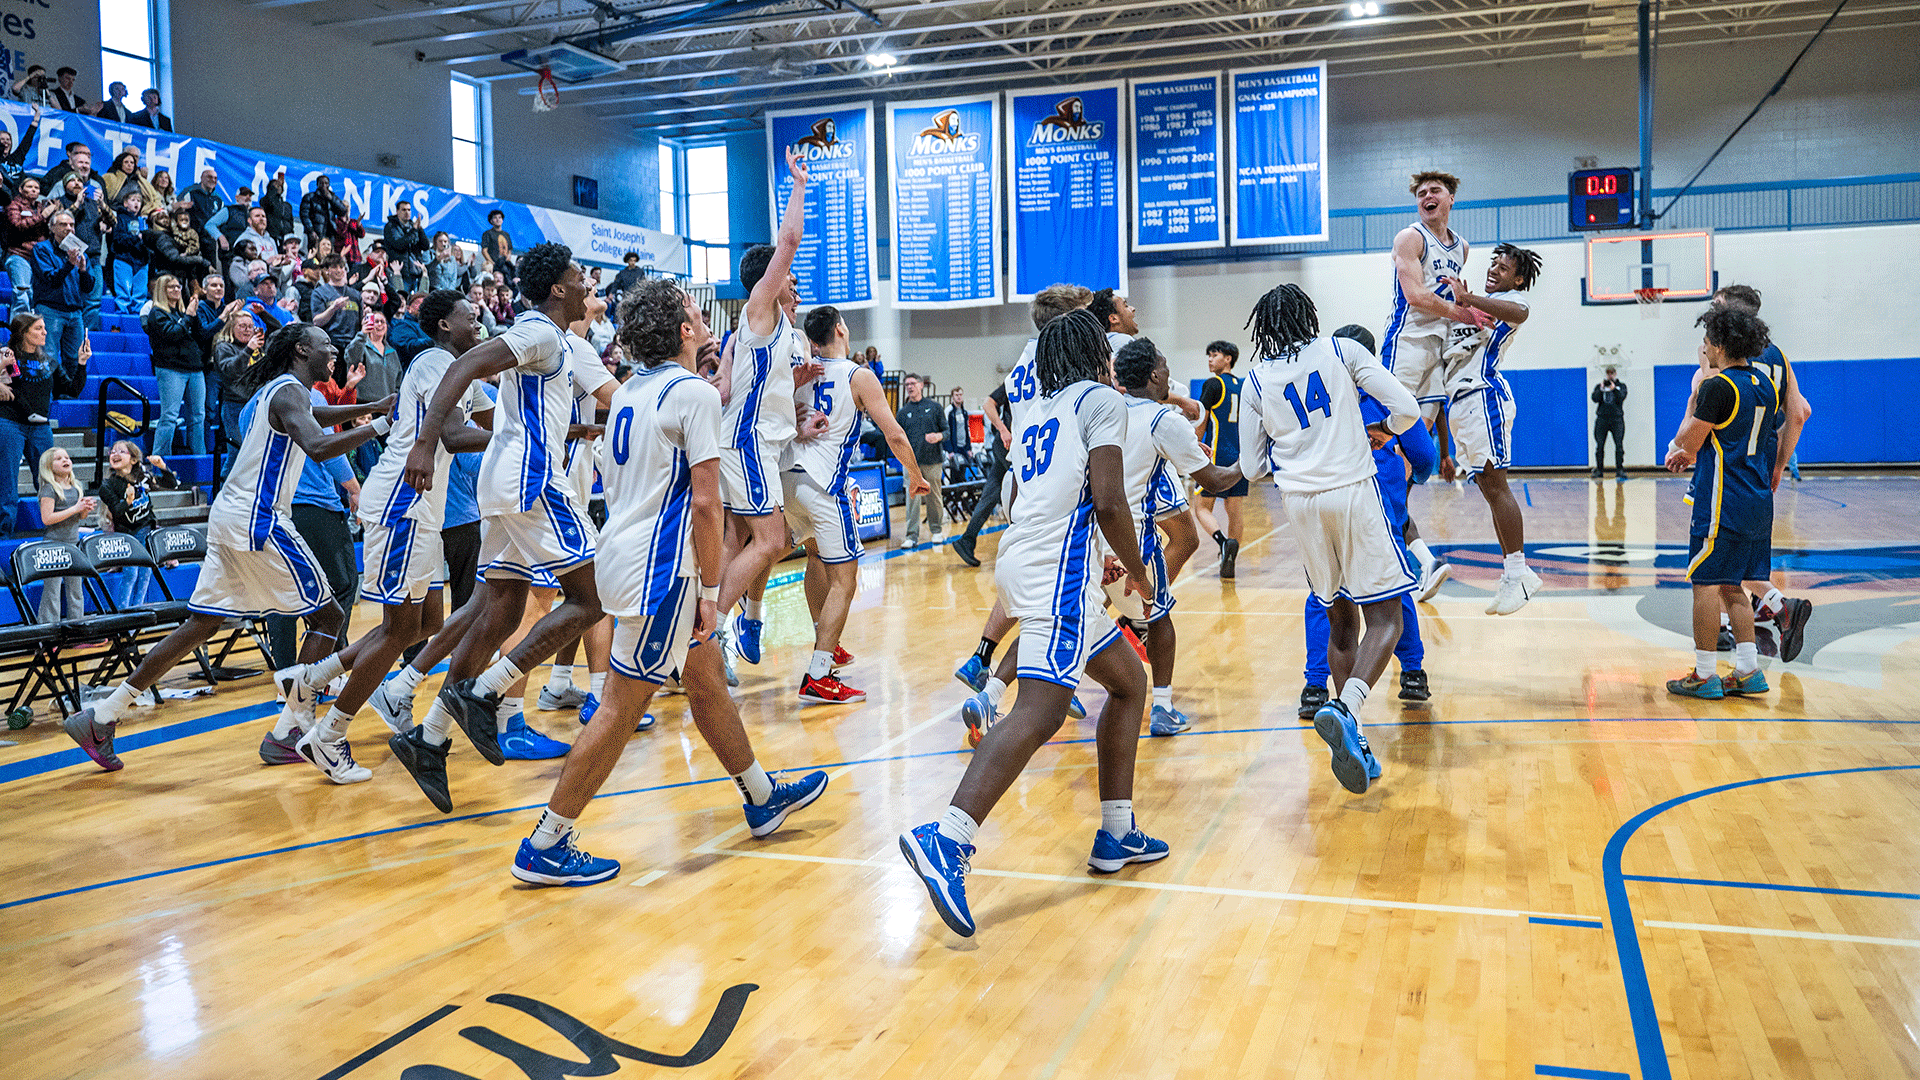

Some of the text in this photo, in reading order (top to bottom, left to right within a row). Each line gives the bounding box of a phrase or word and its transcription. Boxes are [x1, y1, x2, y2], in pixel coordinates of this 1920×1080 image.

[0, 10, 36, 39] es
[1238, 73, 1318, 88] MEN'S BASKETBALL
[1138, 83, 1212, 96] MEN'S BASKETBALL
[1238, 87, 1318, 102] GNAC CHAMPIONS
[1166, 121, 1186, 129] 1987
[1031, 123, 1101, 144] MONKS
[1153, 128, 1200, 138] 1991 1993
[791, 142, 853, 161] MONKS
[910, 135, 977, 156] MONKS
[1056, 144, 1097, 153] BASKETBALL
[1025, 151, 1109, 166] 1000 POINT CLUB
[1141, 152, 1214, 166] 1996 1998 2002
[836, 169, 860, 179] CLUB
[904, 162, 985, 178] 1000 POINT CLUB
[1239, 162, 1318, 176] NCAA TOURNAMENT
[1168, 181, 1188, 191] 1987
[1586, 174, 1617, 196] 0.0
[1142, 205, 1215, 218] 1987 1992 1993
[1142, 214, 1216, 227] 1996 1998 1999
[591, 223, 645, 245] Saint Joseph's
[1168, 224, 1189, 234] 2002
[591, 239, 622, 258] College
[1008, 359, 1036, 404] 35
[813, 381, 835, 416] 15
[1283, 370, 1332, 430] 14
[612, 406, 634, 465] 0
[1747, 405, 1766, 456] 1
[1021, 417, 1060, 483] 33
[101, 539, 122, 548] SAINT
[168, 532, 188, 541] SAINT
[38, 549, 63, 558] SAINT
[100, 545, 130, 558] JOSEPH'S
[36, 554, 70, 569] JOSEPH'S
